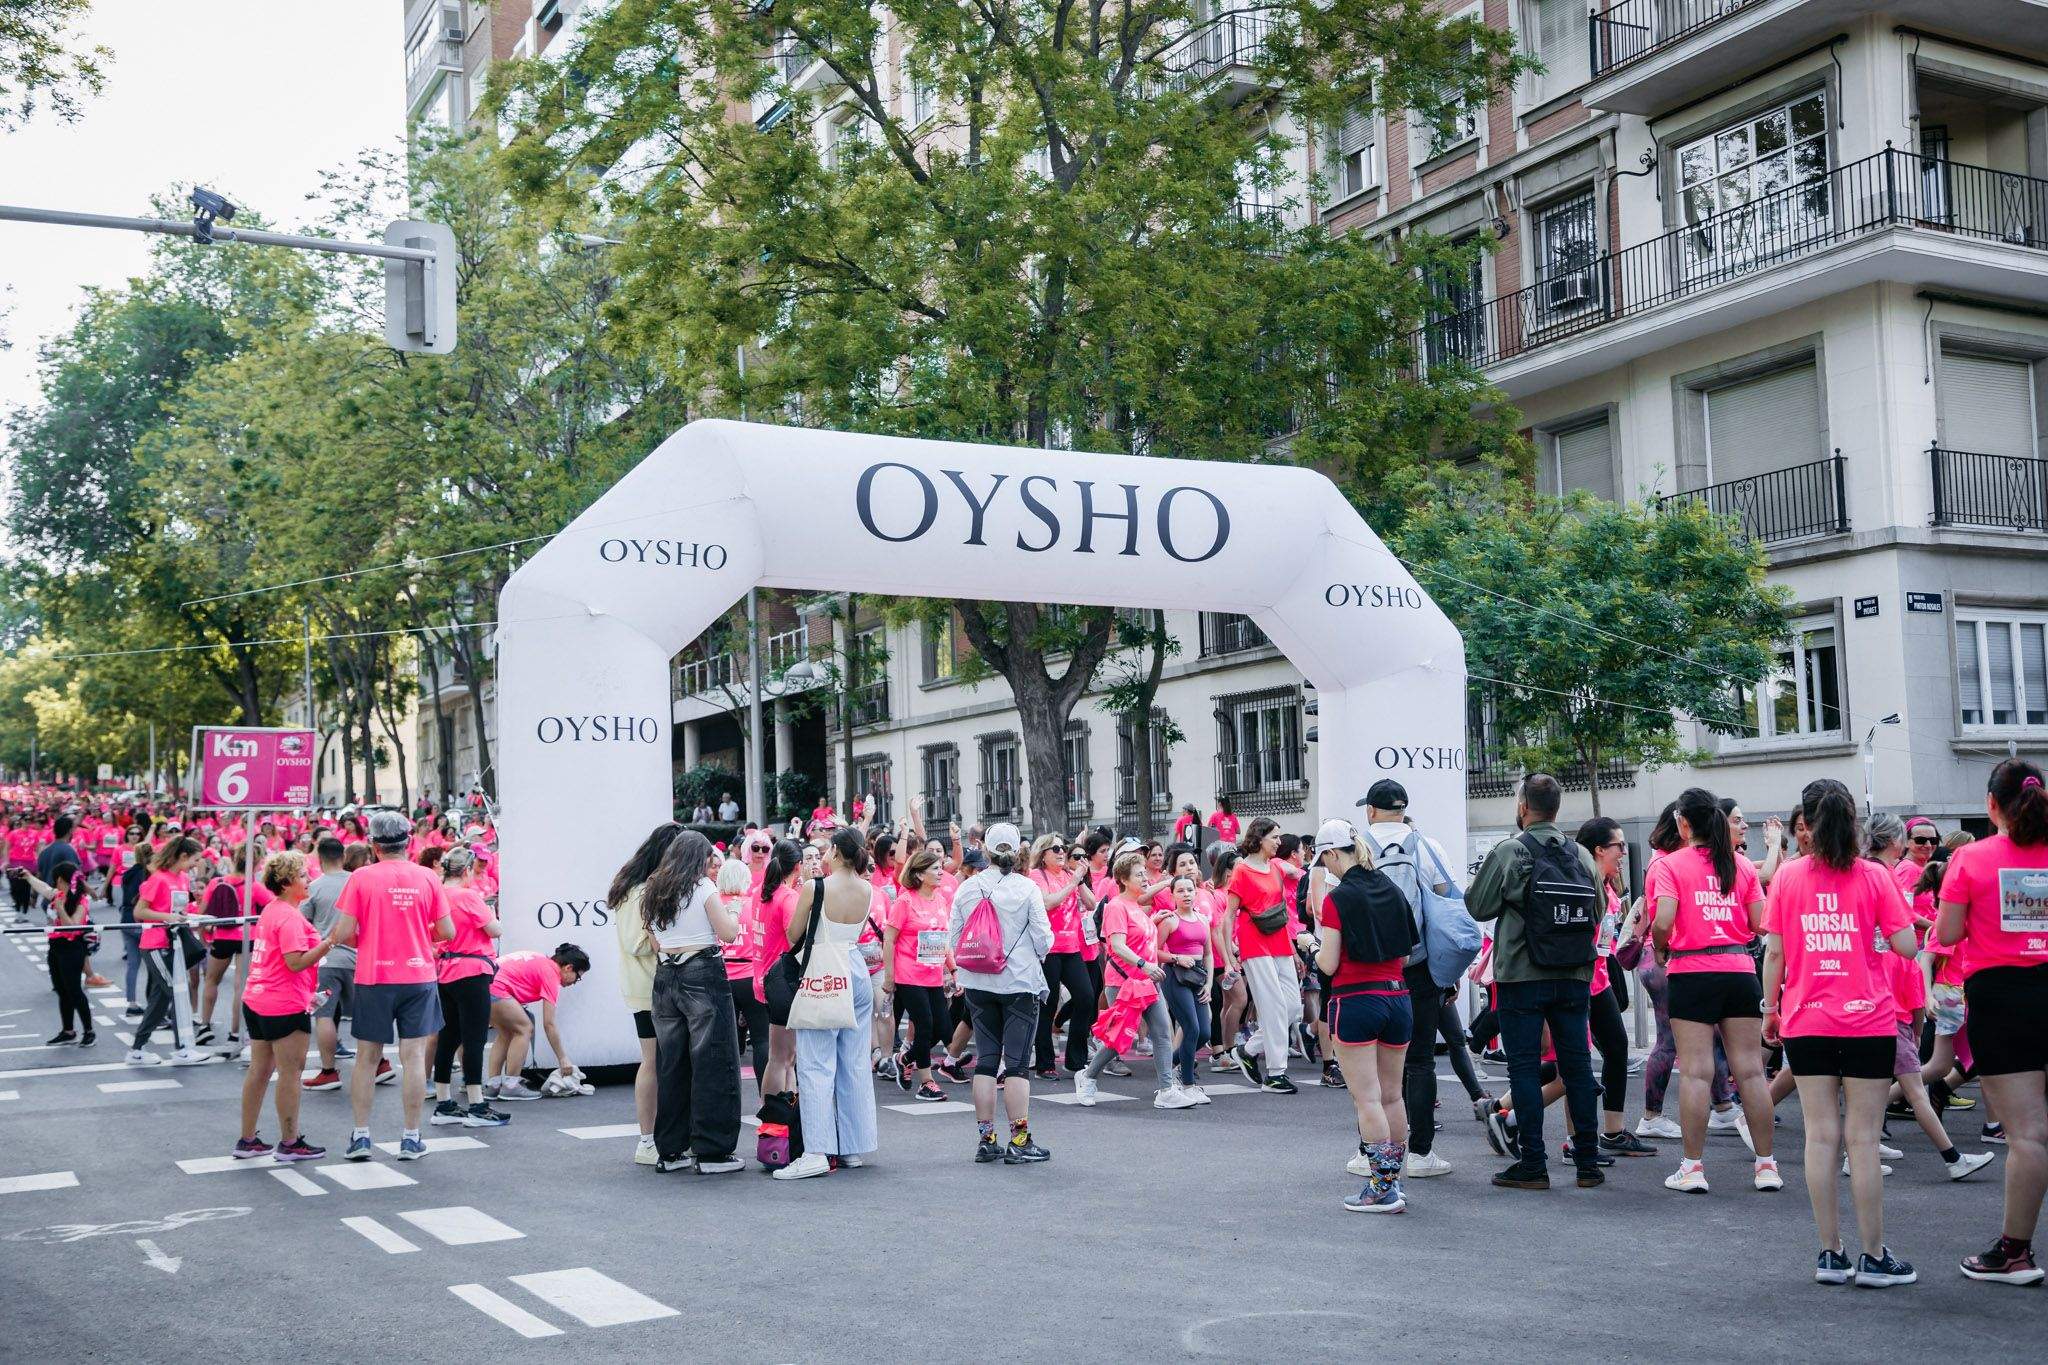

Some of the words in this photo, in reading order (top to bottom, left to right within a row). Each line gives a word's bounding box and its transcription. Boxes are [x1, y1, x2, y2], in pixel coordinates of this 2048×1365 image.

[856, 462, 1231, 563] OYSHO
[600, 539, 728, 571] OYSHO
[1325, 583, 1422, 610] OYSHO
[537, 715, 658, 743] OYSHO
[213, 734, 258, 757] Km
[276, 758, 311, 767] OYSHO
[1374, 746, 1464, 771] OYSHO
[217, 762, 250, 804] 6
[387, 887, 420, 895] CARRERA
[1694, 891, 1739, 906] DORSAL
[1816, 893, 1838, 912] TU
[537, 900, 616, 929] OYS
[1702, 906, 1733, 921] SUMA
[1800, 913, 1859, 932] DORSAL
[1805, 933, 1852, 952] SUMA
[1820, 960, 1841, 970] 2024
